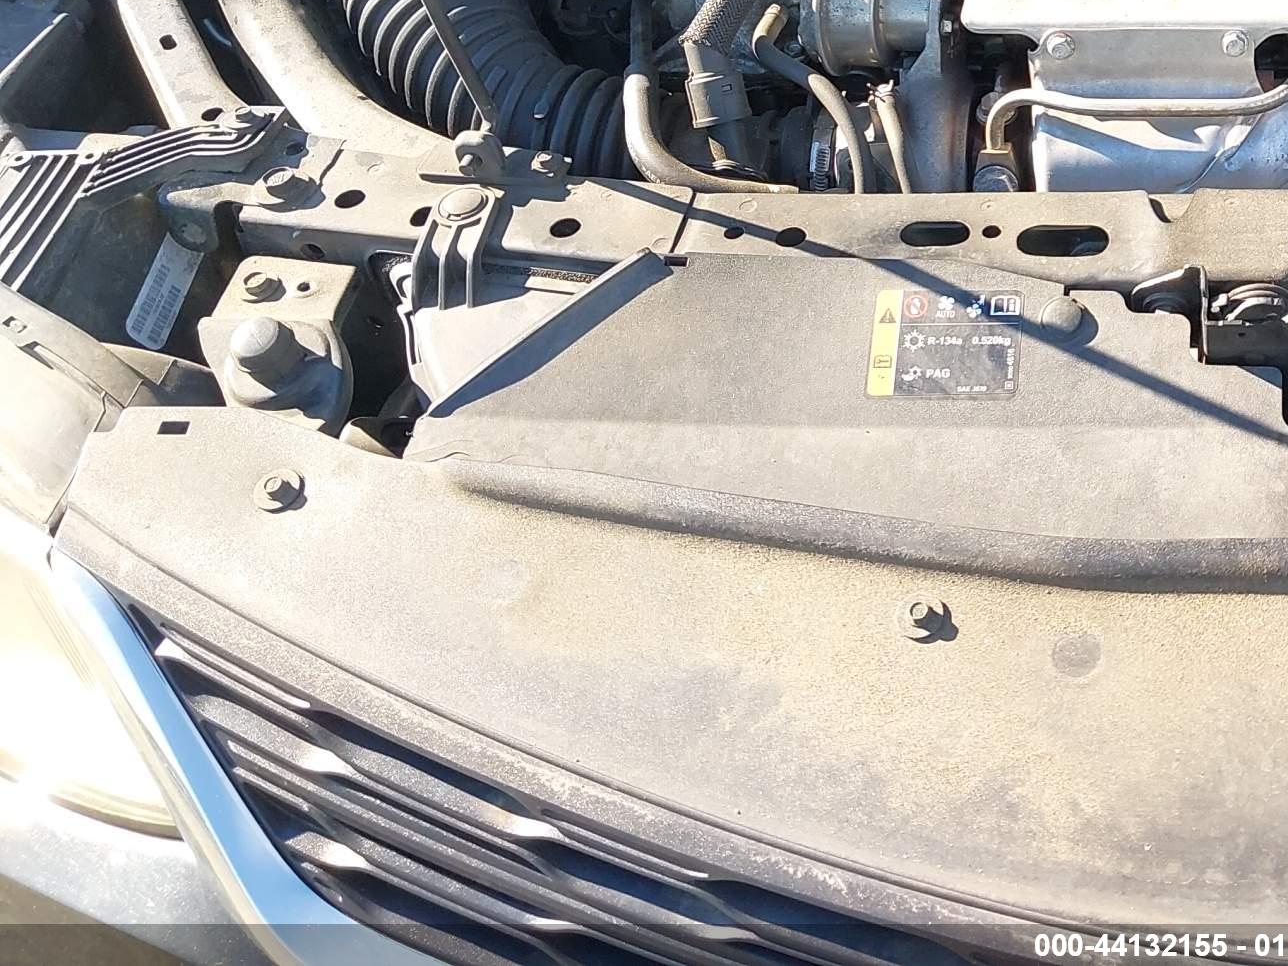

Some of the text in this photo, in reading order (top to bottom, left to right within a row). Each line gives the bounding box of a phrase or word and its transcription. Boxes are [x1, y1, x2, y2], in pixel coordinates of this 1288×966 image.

[936, 310, 955, 318] AUTO
[927, 336, 1012, 346] R-134a 0.520kg
[925, 369, 951, 379] PAG
